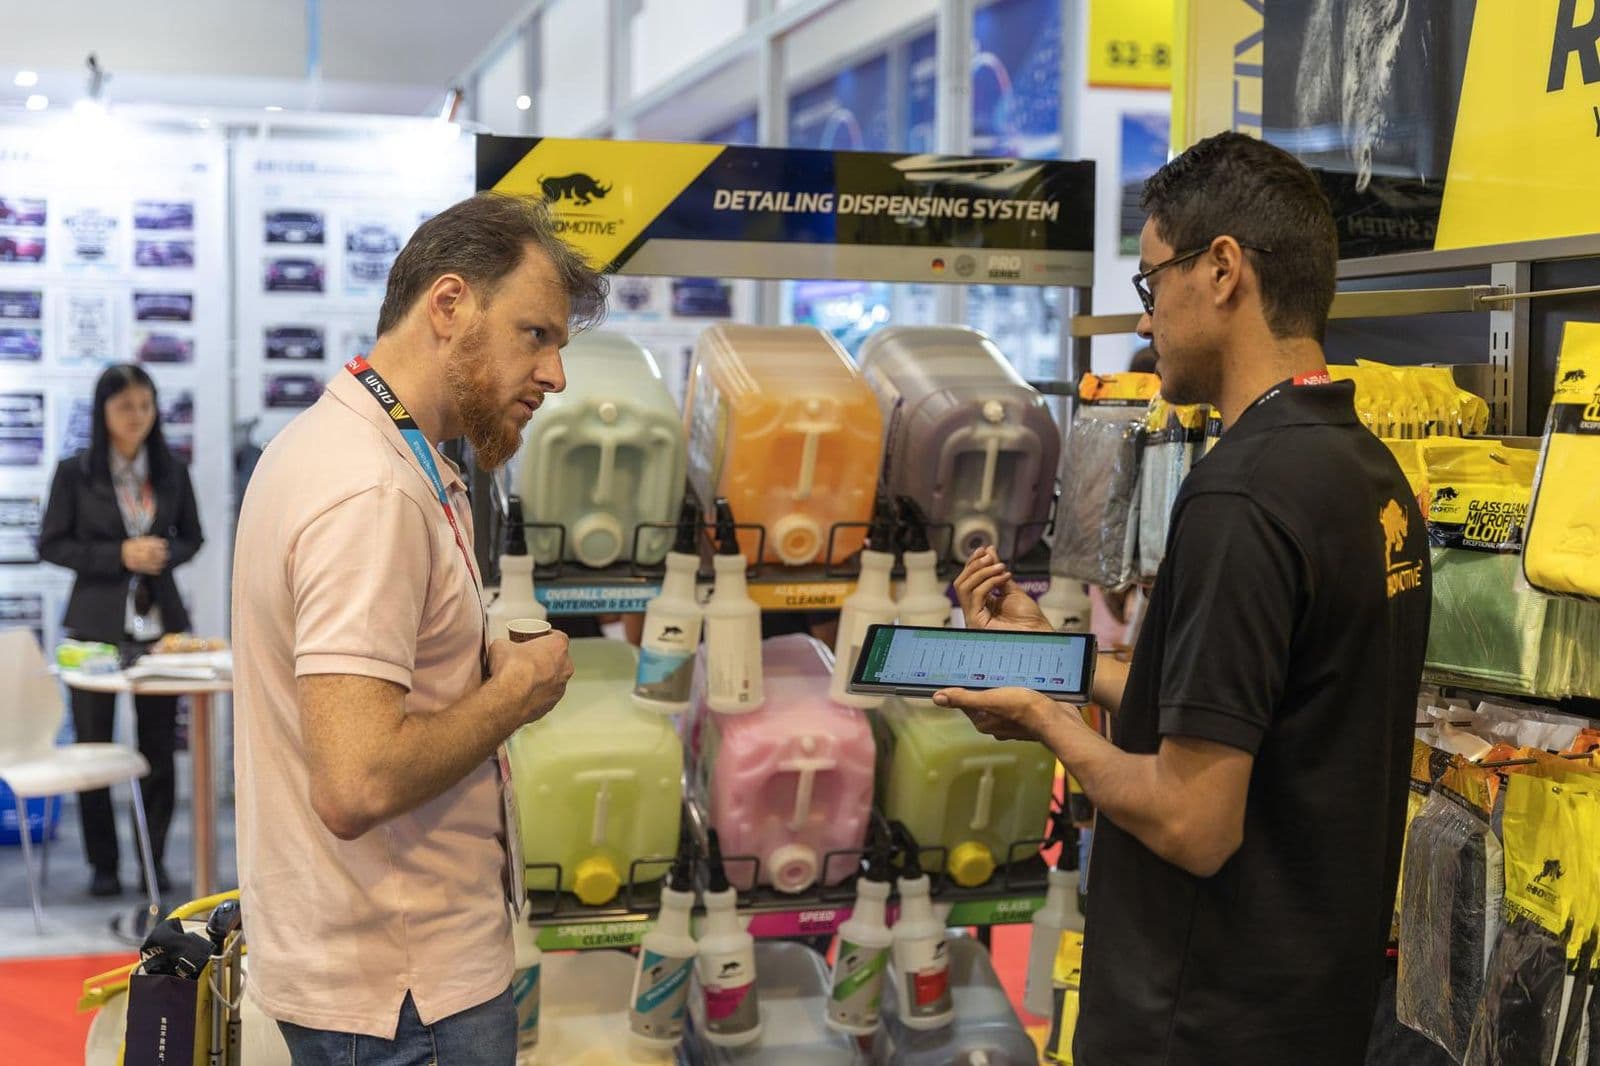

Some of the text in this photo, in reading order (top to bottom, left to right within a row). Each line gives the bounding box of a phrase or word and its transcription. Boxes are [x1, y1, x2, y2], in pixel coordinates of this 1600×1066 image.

[713, 189, 1060, 222] DETAILING DISPENSING SYSTEM
[988, 255, 1022, 270] PRO
[1468, 500, 1502, 513] GLASS
[1463, 524, 1511, 543] CLOTH
[544, 588, 601, 600] OVERALL
[785, 595, 836, 606] CLEANER
[551, 600, 602, 610] INTERIOR
[620, 600, 646, 609] EXTE
[799, 911, 835, 922] SPEED
[557, 924, 604, 937] SPECIAL
[582, 933, 634, 946] CLEANER
